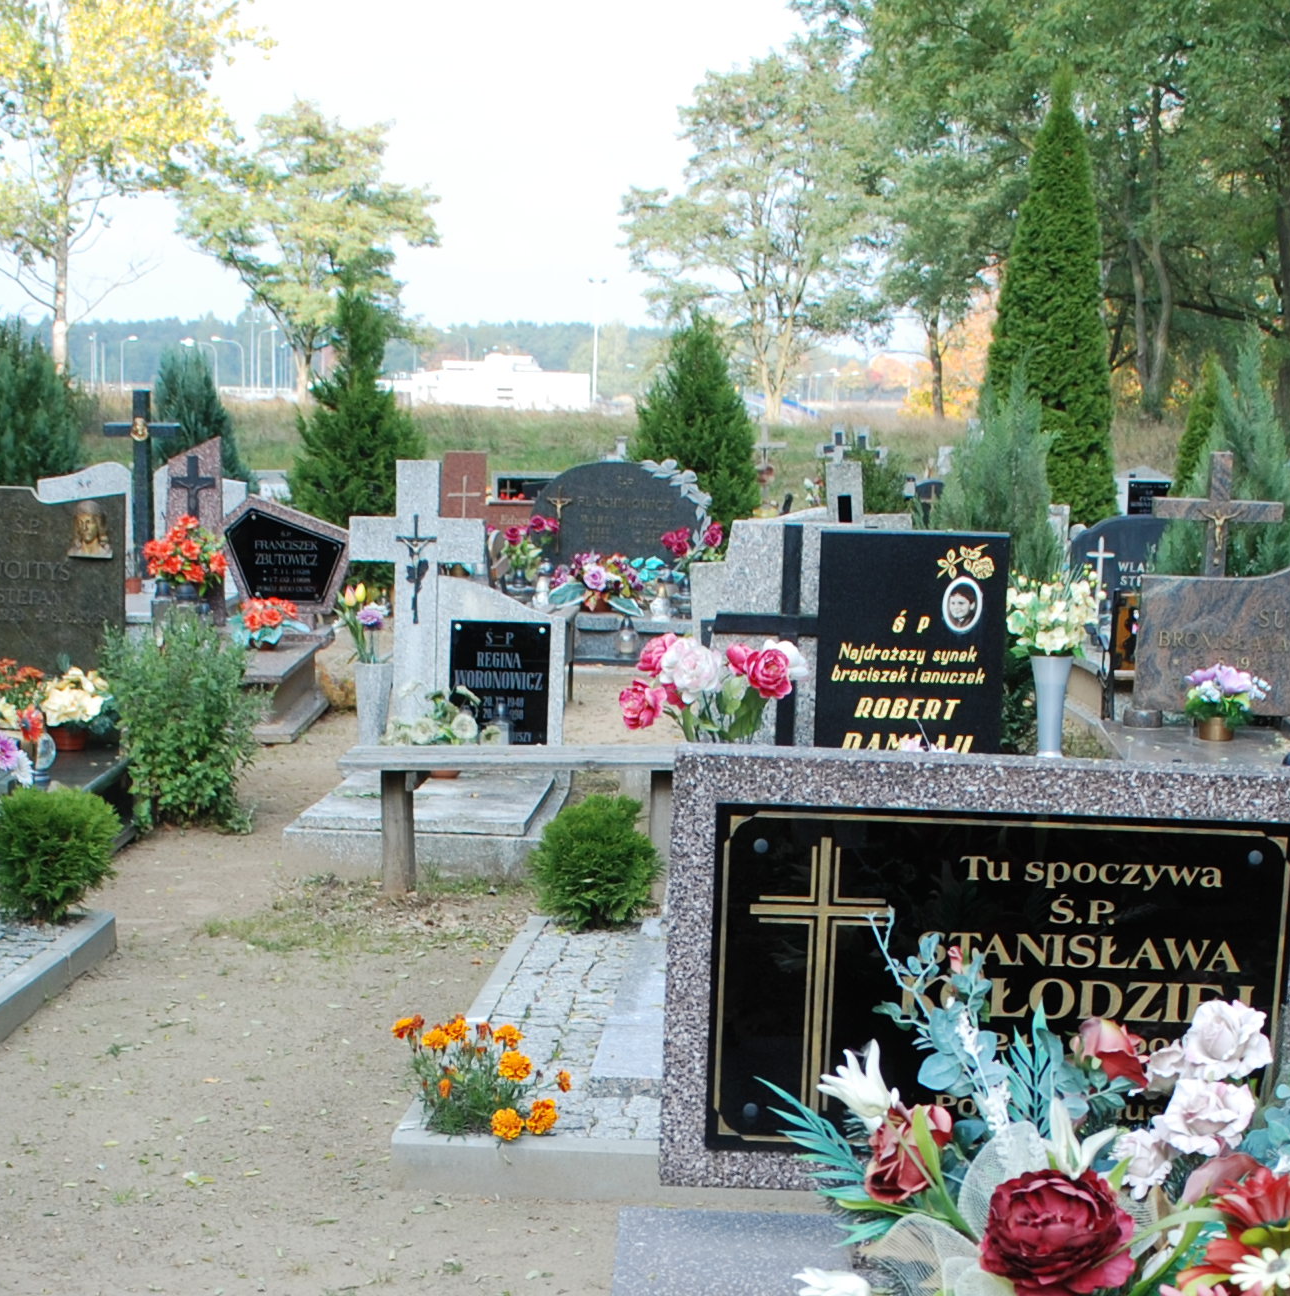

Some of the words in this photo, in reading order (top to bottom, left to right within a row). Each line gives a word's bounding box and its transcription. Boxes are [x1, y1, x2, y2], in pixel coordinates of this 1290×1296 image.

[254, 540, 319, 551] FRANCISZEK
[255, 553, 318, 566] ZBUTOWICZ
[476, 651, 522, 669] REGINA
[838, 642, 927, 665] Najdroższy
[932, 645, 978, 666] synek
[454, 669, 544, 691] WORONOWICZ
[831, 664, 909, 684] braciszek
[910, 666, 918, 683] i
[919, 667, 986, 685] wnuczek
[854, 696, 962, 720] ROBERT
[959, 855, 1011, 882] Tu
[1023, 858, 1223, 891] spoczywa
[919, 931, 1241, 974] STANISŁAWA
